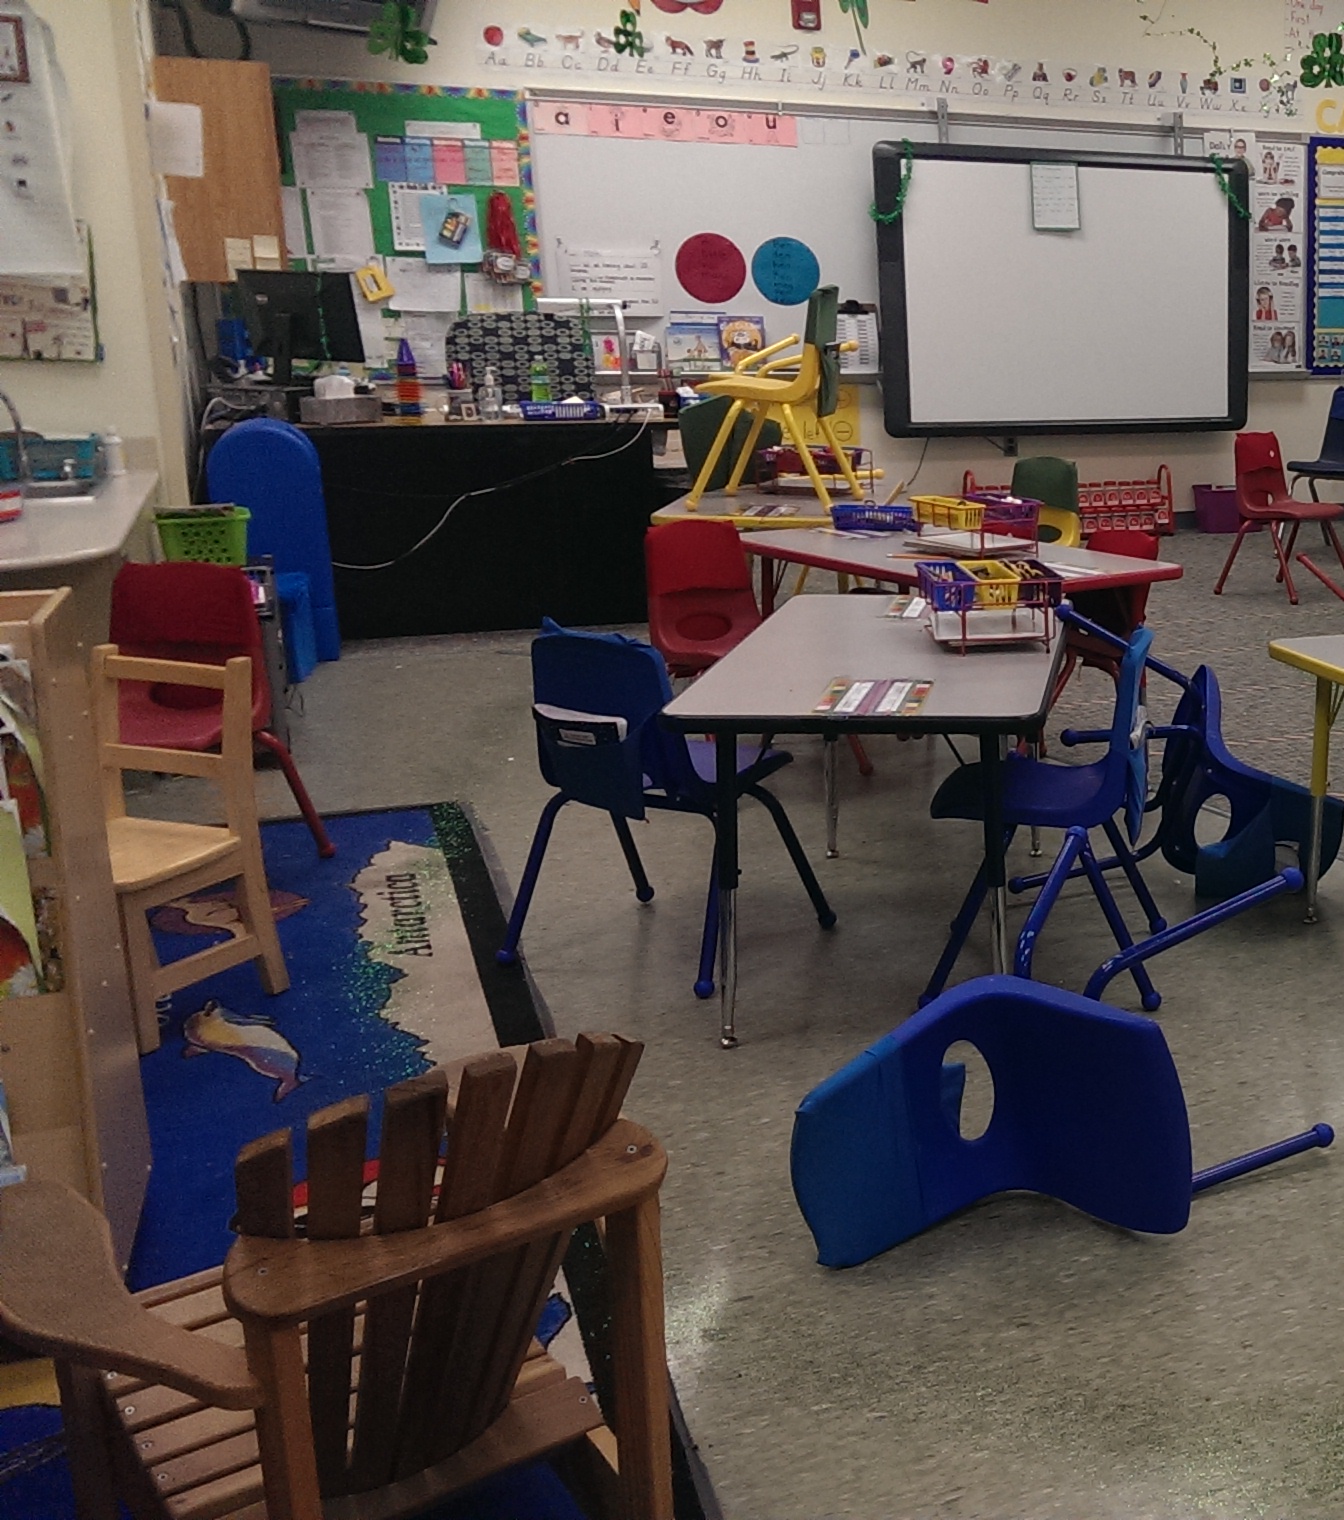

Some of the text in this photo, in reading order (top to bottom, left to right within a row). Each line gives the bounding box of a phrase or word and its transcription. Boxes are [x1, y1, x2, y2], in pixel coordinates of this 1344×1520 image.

[555, 111, 777, 132] a i e o u
[376, 872, 434, 957] Antarctica
